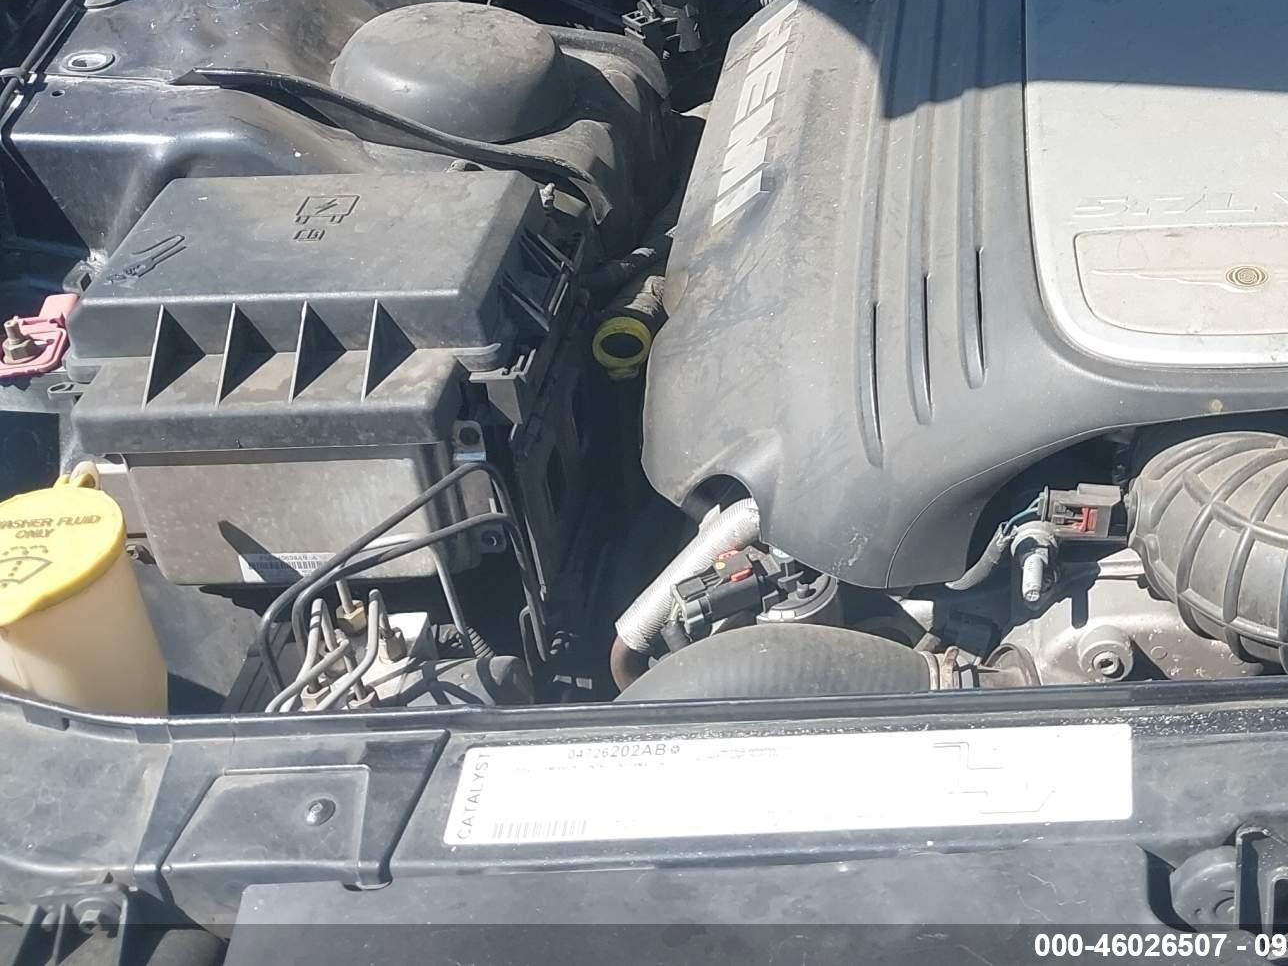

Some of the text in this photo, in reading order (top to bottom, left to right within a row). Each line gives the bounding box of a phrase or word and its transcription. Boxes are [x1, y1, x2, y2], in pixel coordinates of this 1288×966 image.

[57, 514, 102, 527] FLUID
[15, 528, 55, 539] ONLY
[456, 752, 491, 840] CATALYST
